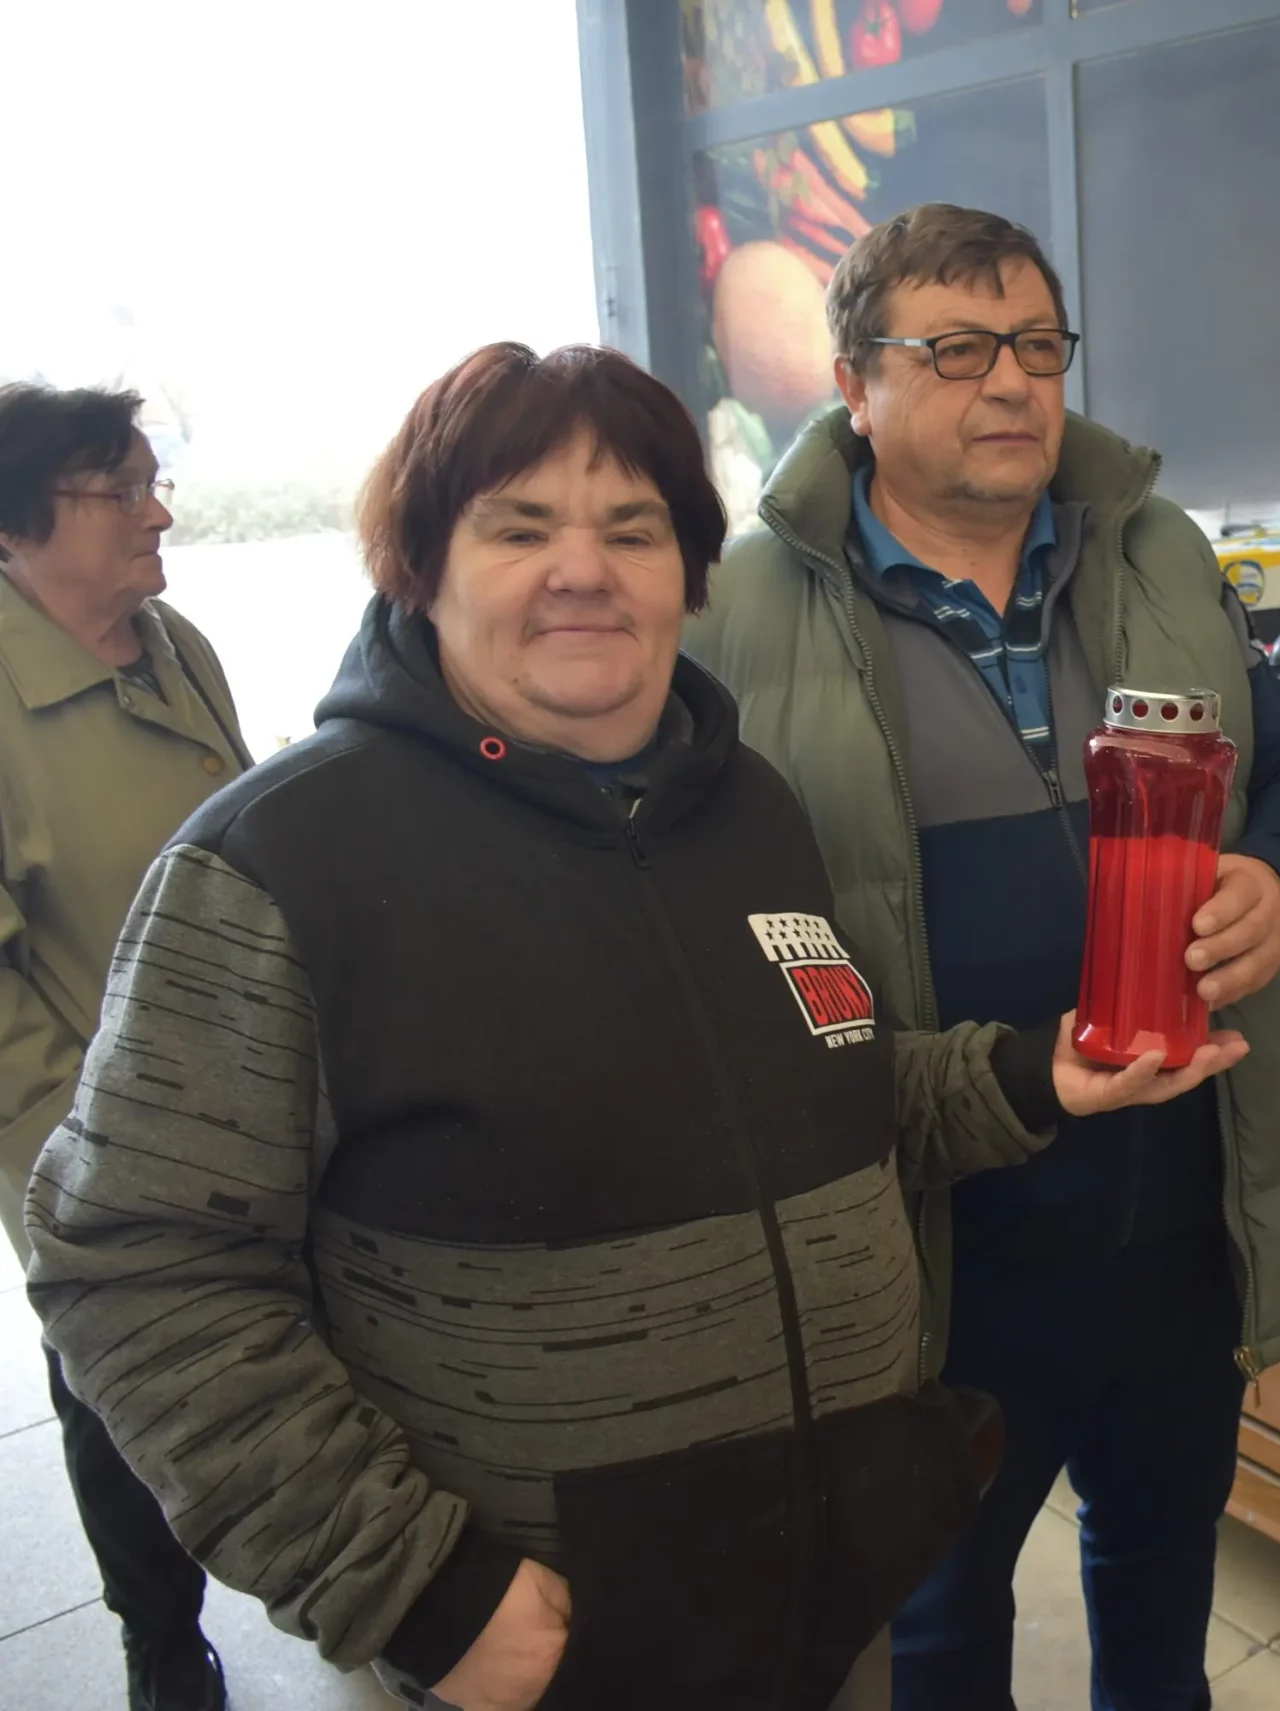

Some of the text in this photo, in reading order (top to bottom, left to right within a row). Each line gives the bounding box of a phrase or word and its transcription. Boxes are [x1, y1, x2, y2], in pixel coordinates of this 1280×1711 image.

[791, 966, 872, 1026] BRONX
[825, 1027, 875, 1049] NEW YORK CITY
